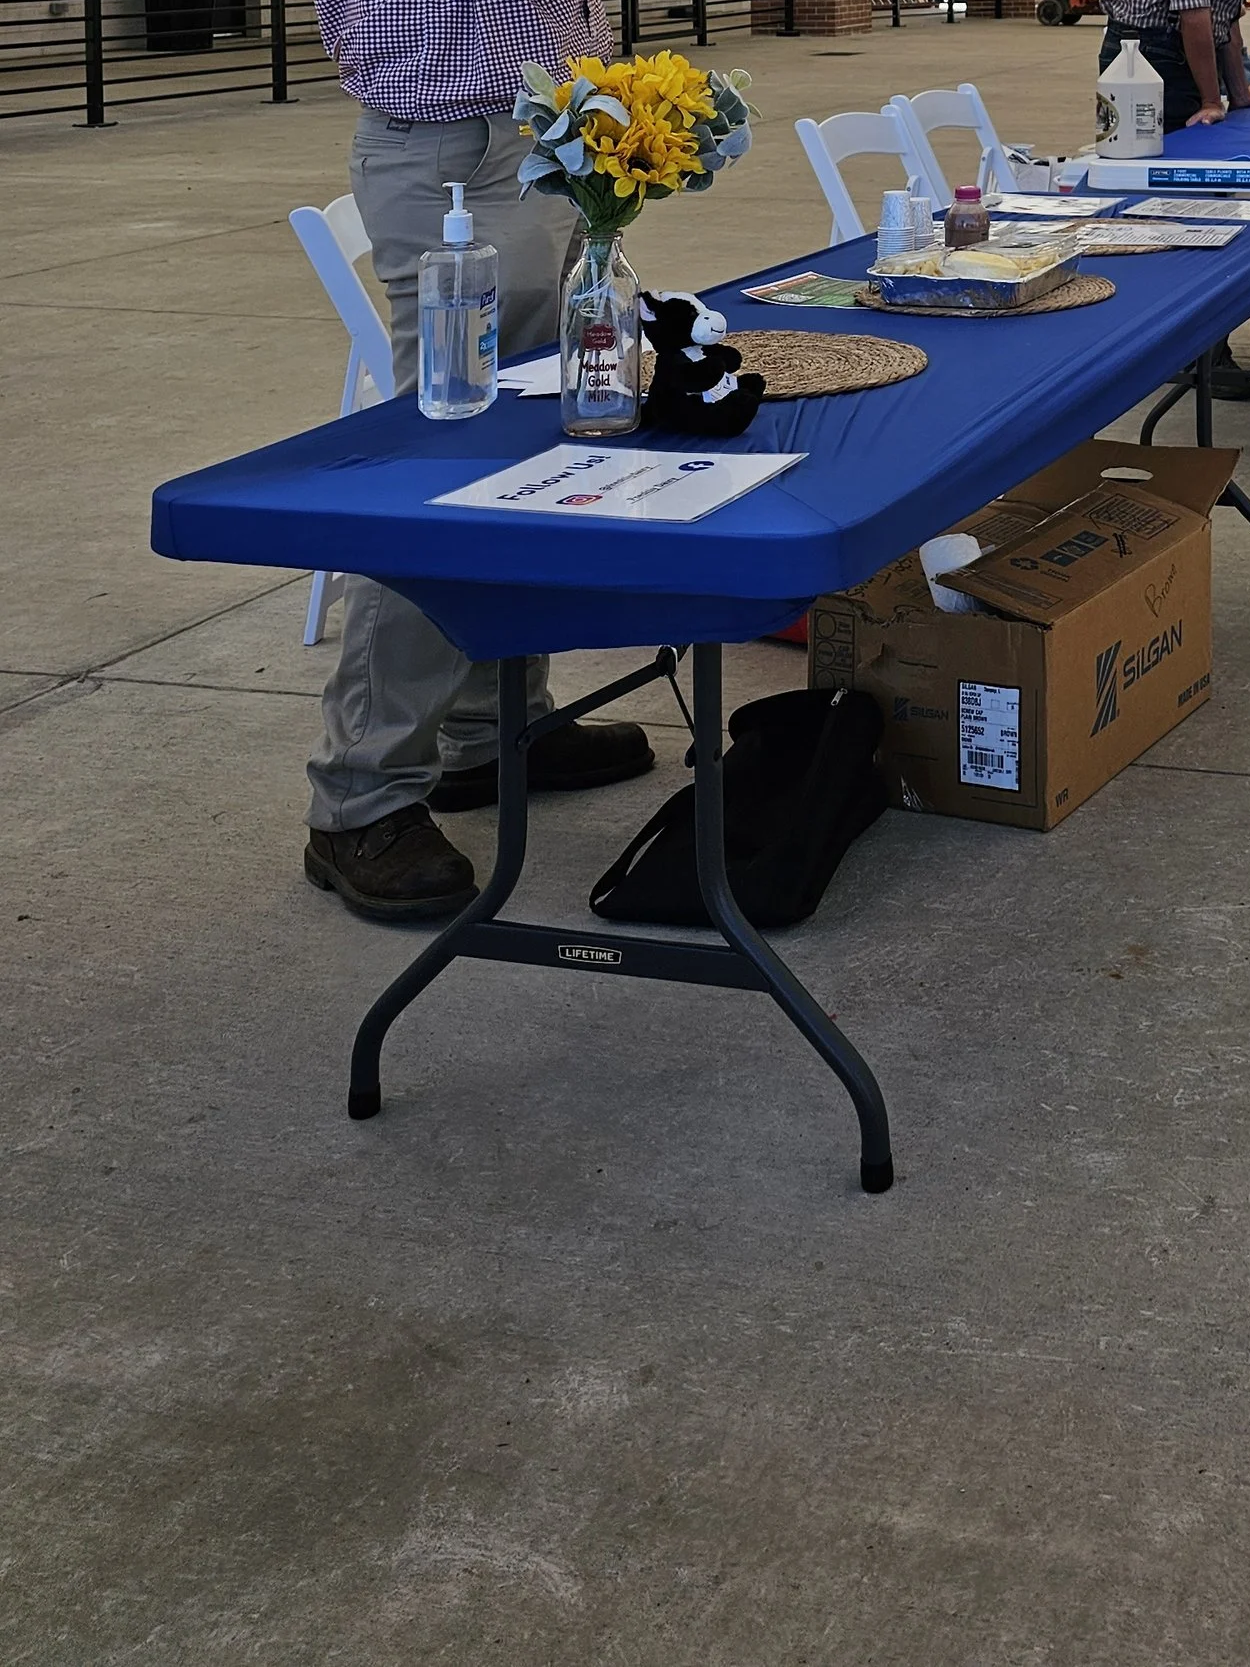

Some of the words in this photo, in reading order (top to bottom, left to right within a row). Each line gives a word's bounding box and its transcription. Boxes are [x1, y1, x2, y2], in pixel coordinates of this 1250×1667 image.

[580, 359, 617, 373] Meadow
[588, 375, 610, 387] Gold
[588, 390, 610, 402] Milk
[496, 471, 575, 500] Follow
[565, 455, 611, 470] Us!
[1123, 619, 1182, 690] SILGAN
[1177, 686, 1192, 708] MADE
[1200, 673, 1210, 690] USA
[1056, 787, 1069, 808] WR
[566, 948, 614, 961] LIFETIME
